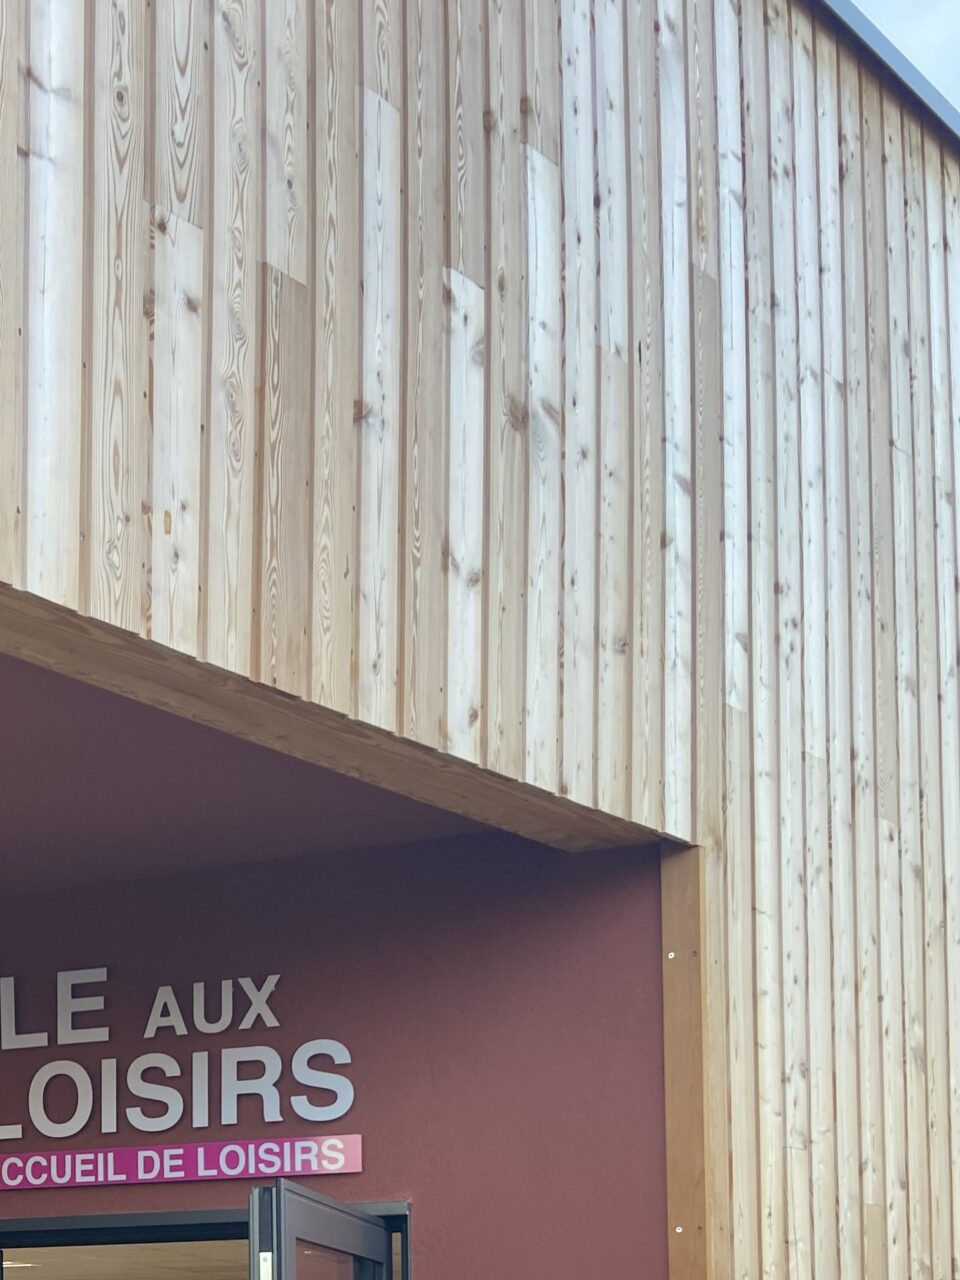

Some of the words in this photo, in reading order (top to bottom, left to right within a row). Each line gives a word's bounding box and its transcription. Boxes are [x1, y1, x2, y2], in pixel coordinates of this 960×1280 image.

[143, 974, 281, 1038] AUX
[137, 1149, 184, 1178] DE
[197, 1138, 345, 1176] LOISIRS
